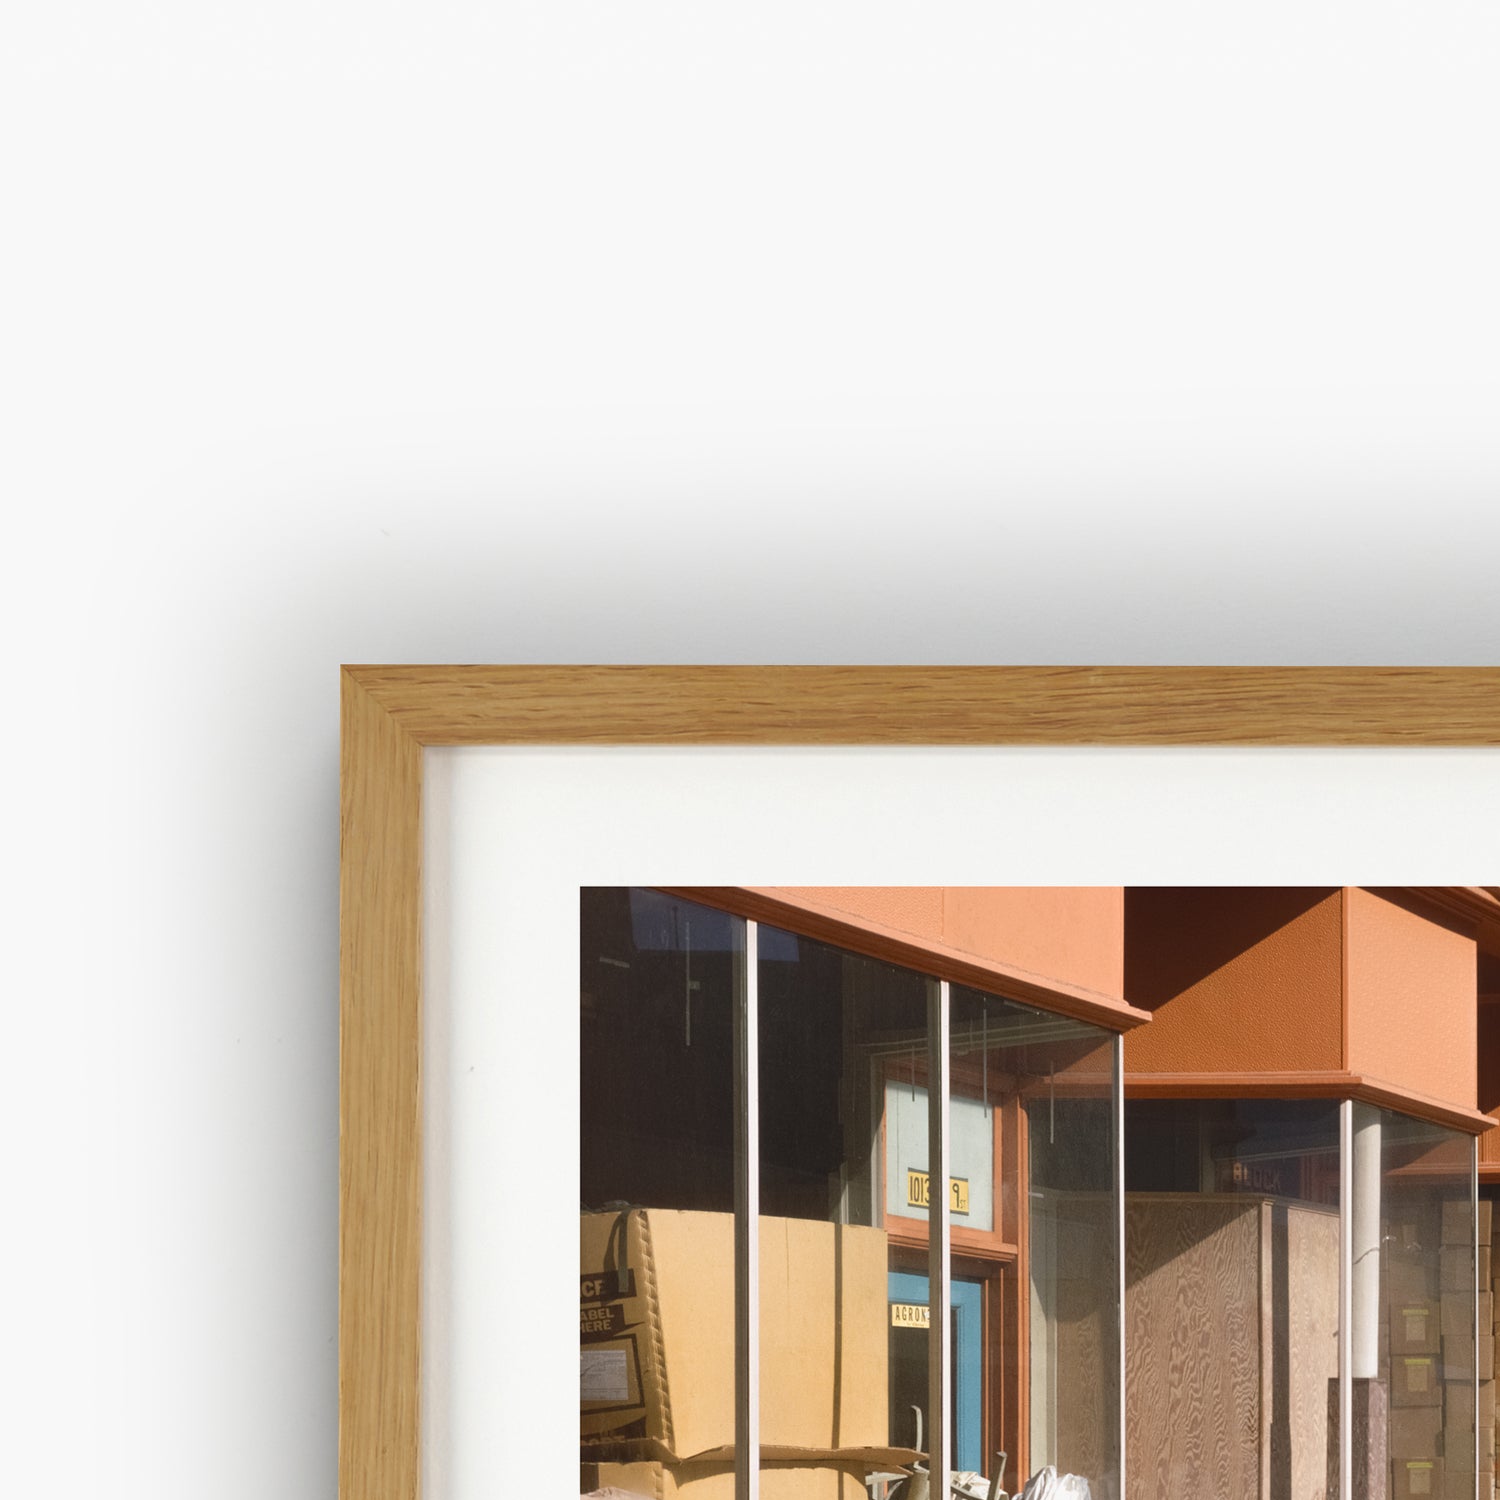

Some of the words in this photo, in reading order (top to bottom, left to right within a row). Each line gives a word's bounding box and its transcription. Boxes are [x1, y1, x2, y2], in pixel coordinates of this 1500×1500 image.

[909, 1175, 930, 1204] 1013
[952, 1182, 960, 1209] 9
[580, 1280, 606, 1298] CE
